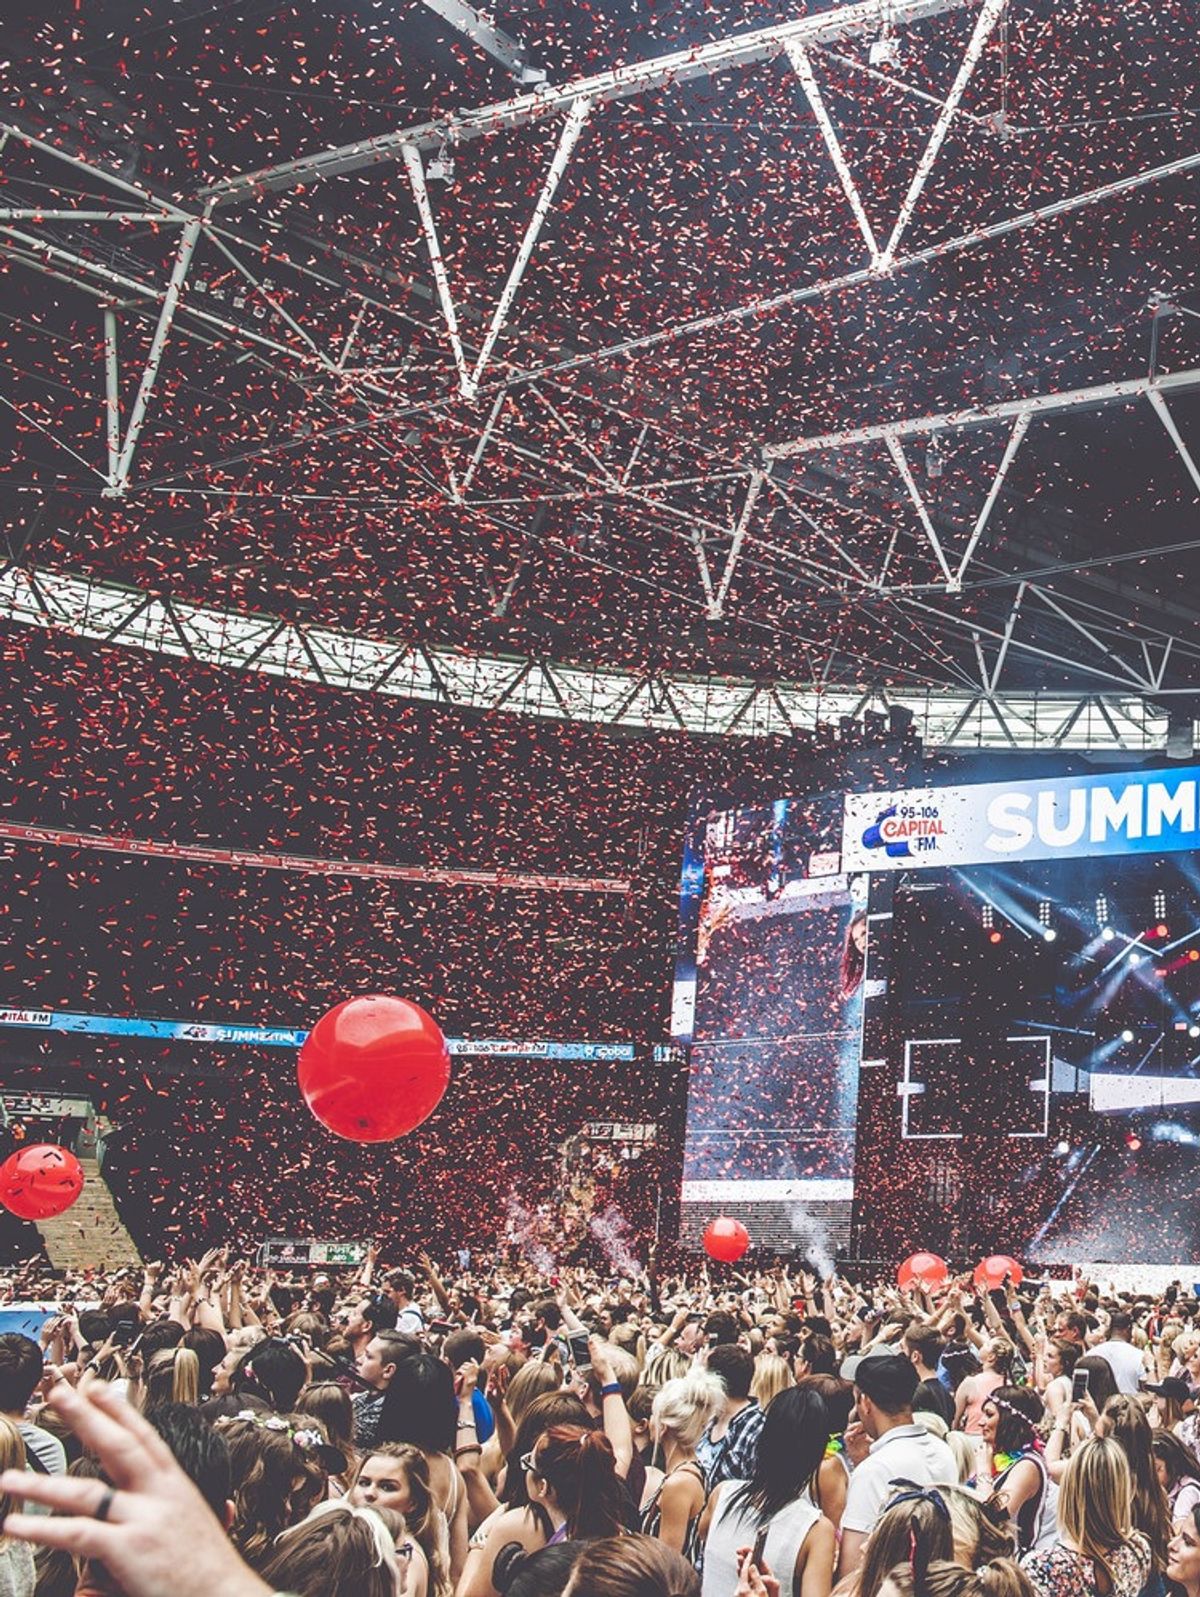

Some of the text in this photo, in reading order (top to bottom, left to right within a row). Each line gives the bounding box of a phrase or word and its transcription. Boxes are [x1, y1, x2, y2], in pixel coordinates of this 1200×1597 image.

[900, 806, 939, 818] 95-106
[883, 819, 945, 837] CAPITAL
[917, 837, 936, 850] FM
